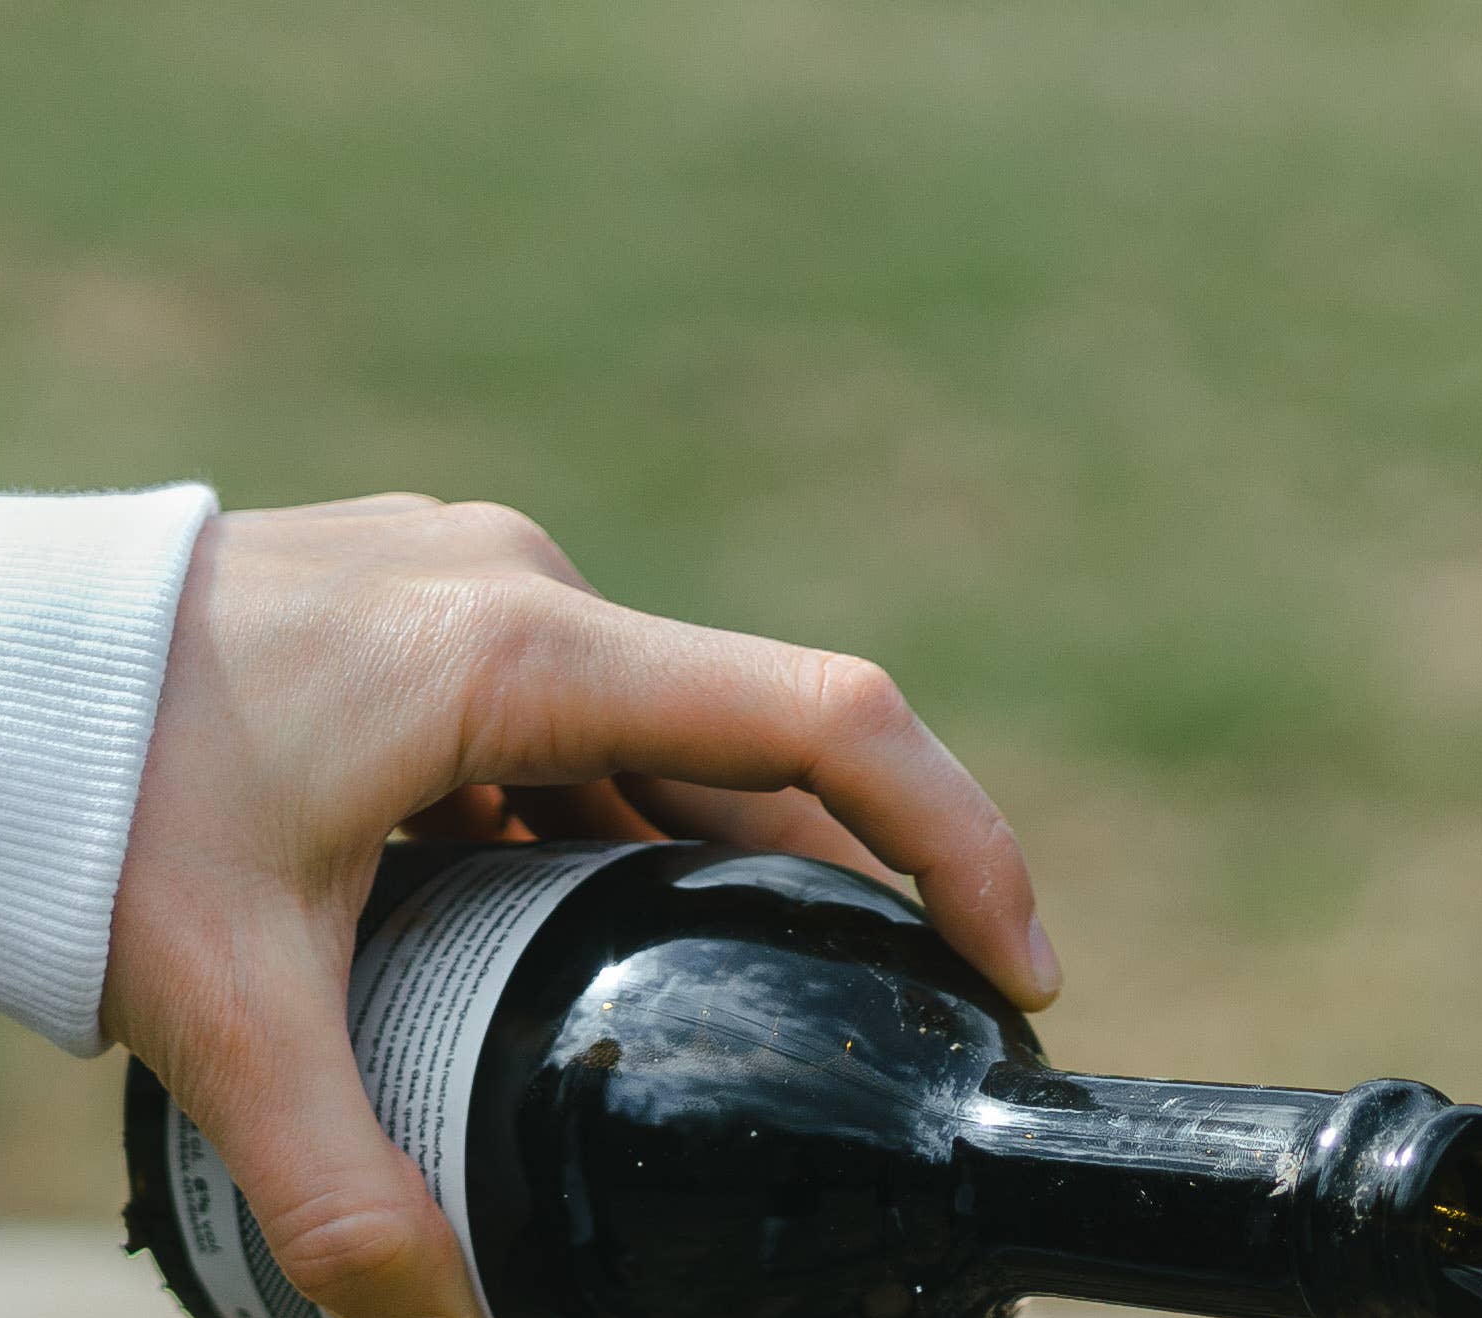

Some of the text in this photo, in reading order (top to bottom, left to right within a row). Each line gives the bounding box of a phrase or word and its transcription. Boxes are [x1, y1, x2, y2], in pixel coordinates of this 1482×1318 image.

[435, 943, 473, 998] Fundació
[467, 944, 503, 995] BdeGust
[411, 978, 438, 1020] centre
[441, 982, 467, 1022] nostra
[413, 1000, 443, 1066] Santuario
[427, 1022, 449, 1073] cervesa
[394, 1038, 414, 1083] rescat
[422, 1073, 436, 1101] més
[436, 1070, 452, 1113] nostra
[401, 1106, 415, 1134] que
